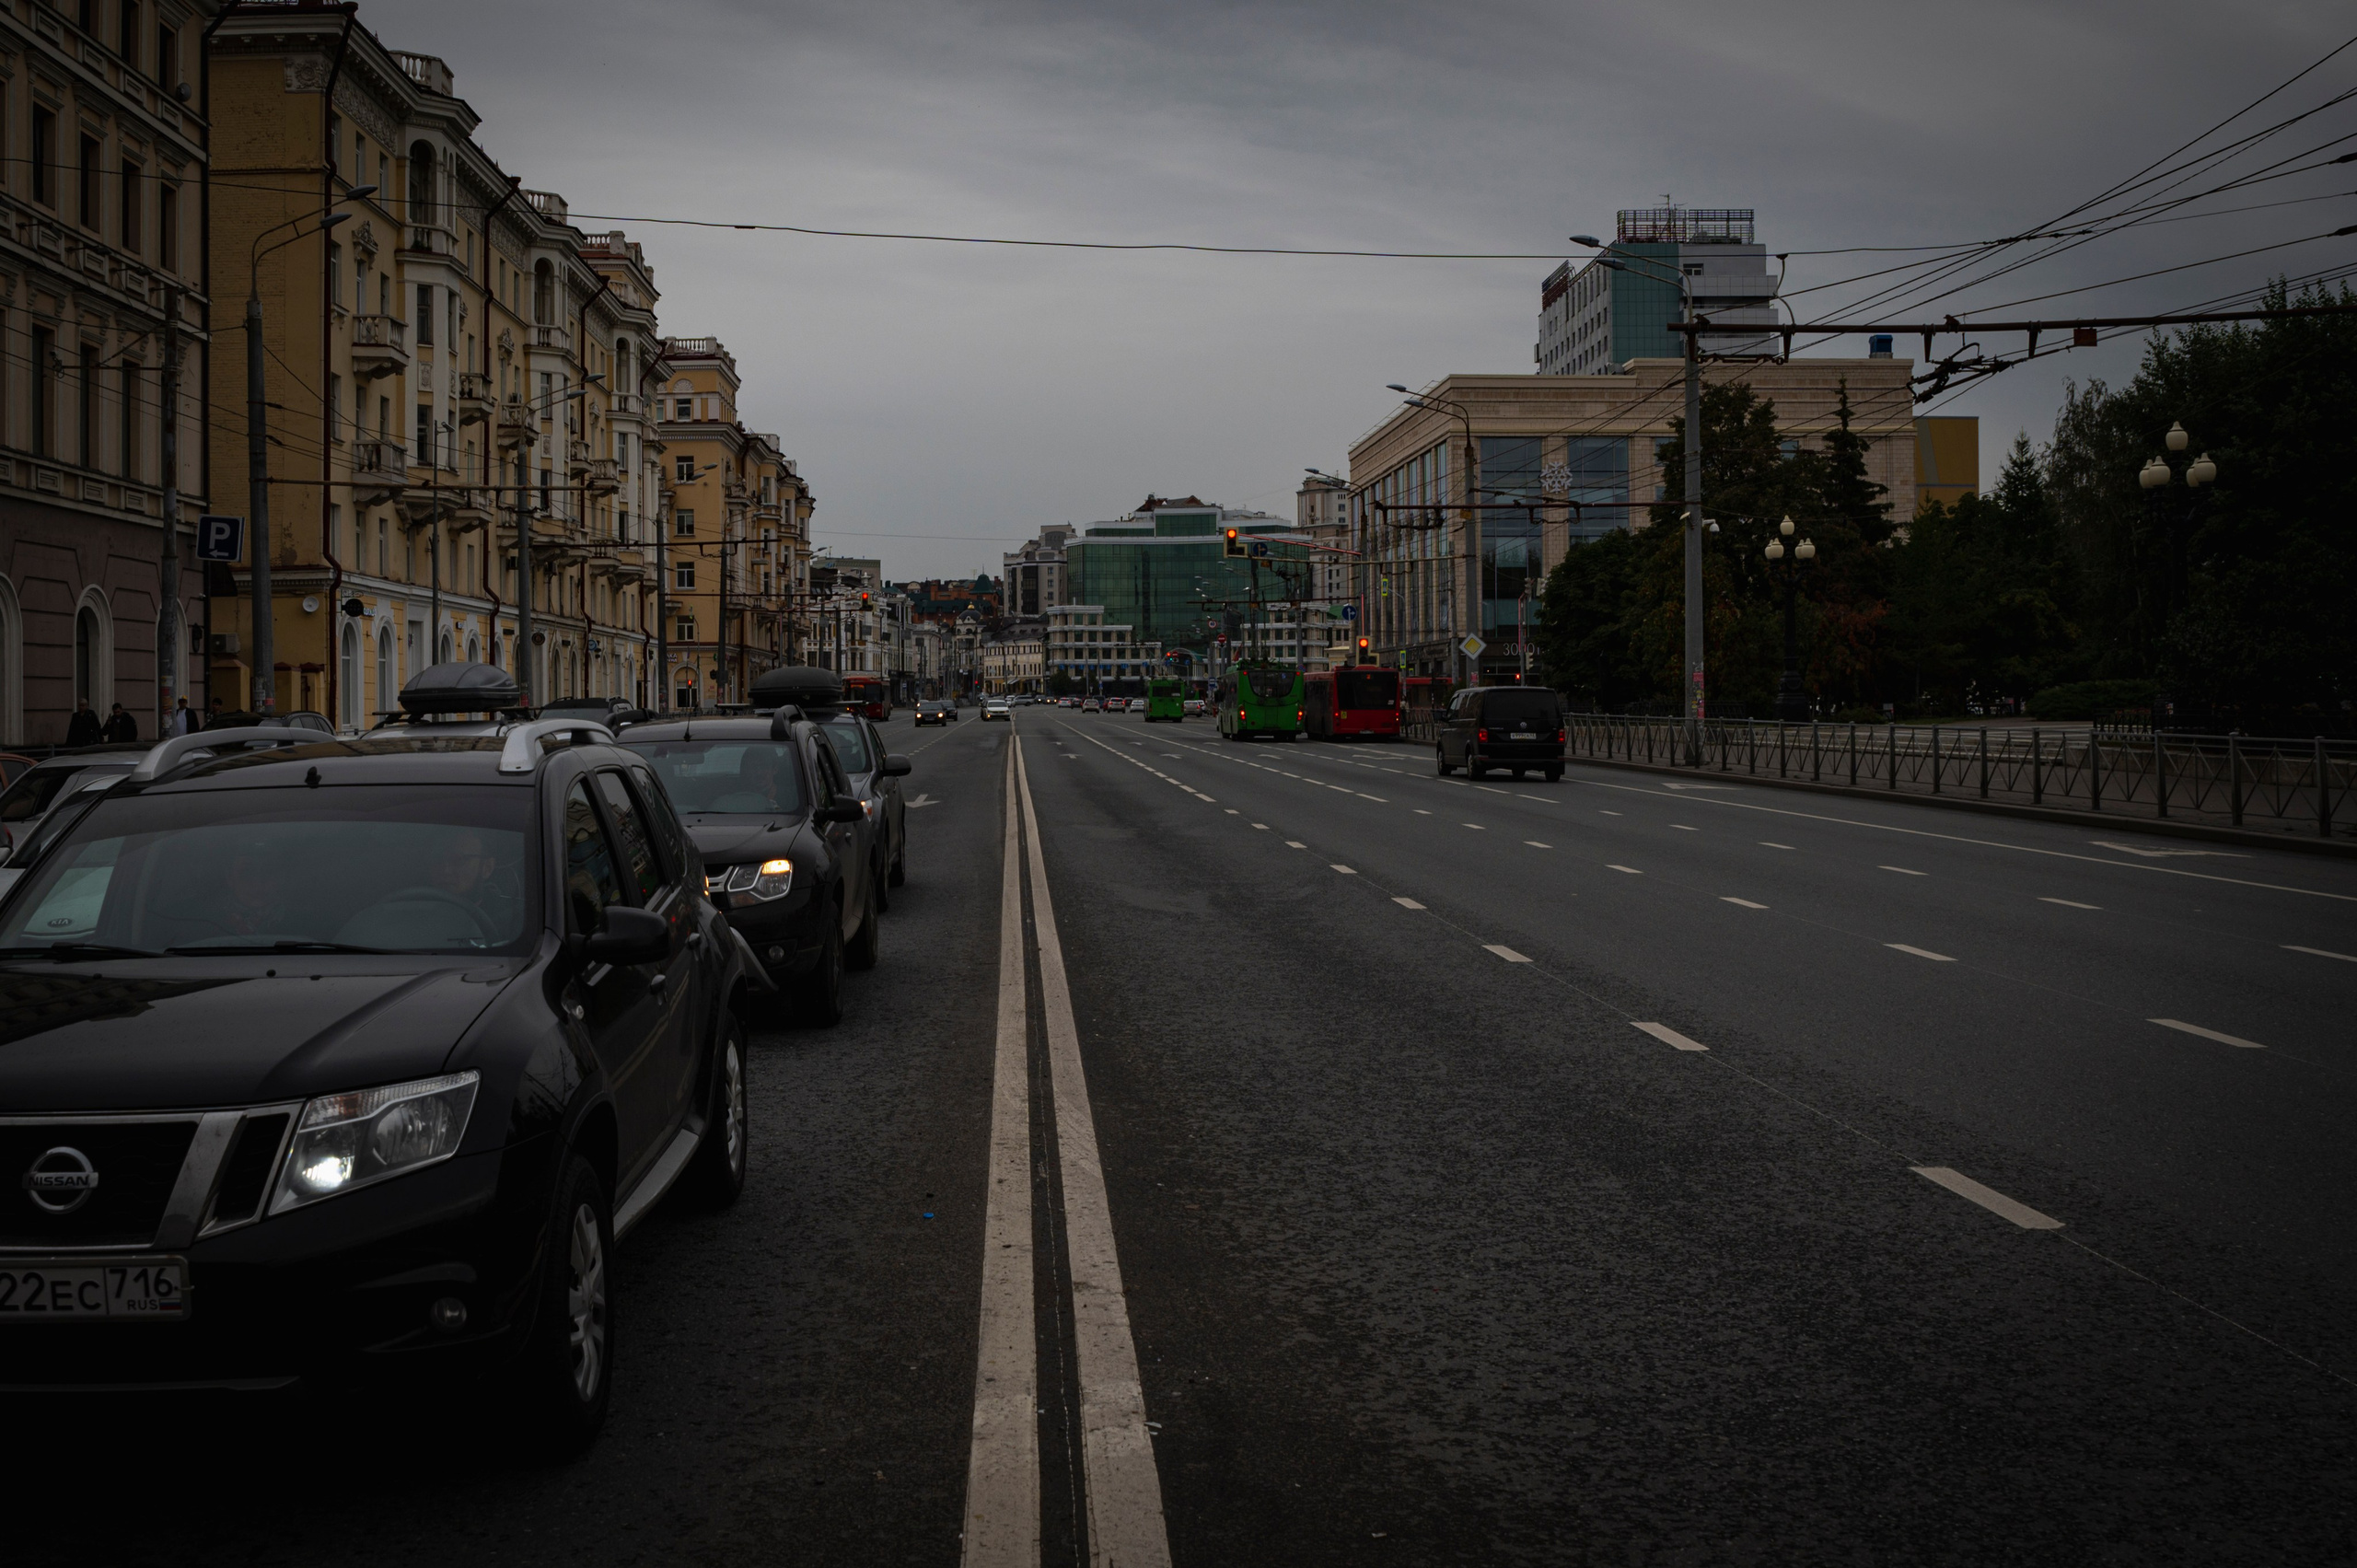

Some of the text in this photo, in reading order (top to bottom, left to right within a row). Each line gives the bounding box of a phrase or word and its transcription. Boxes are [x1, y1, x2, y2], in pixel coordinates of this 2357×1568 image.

[209, 522, 231, 550] P
[29, 1175, 90, 1187] NISSAN
[109, 1268, 173, 1298] 716
[127, 1299, 158, 1311] RUS
